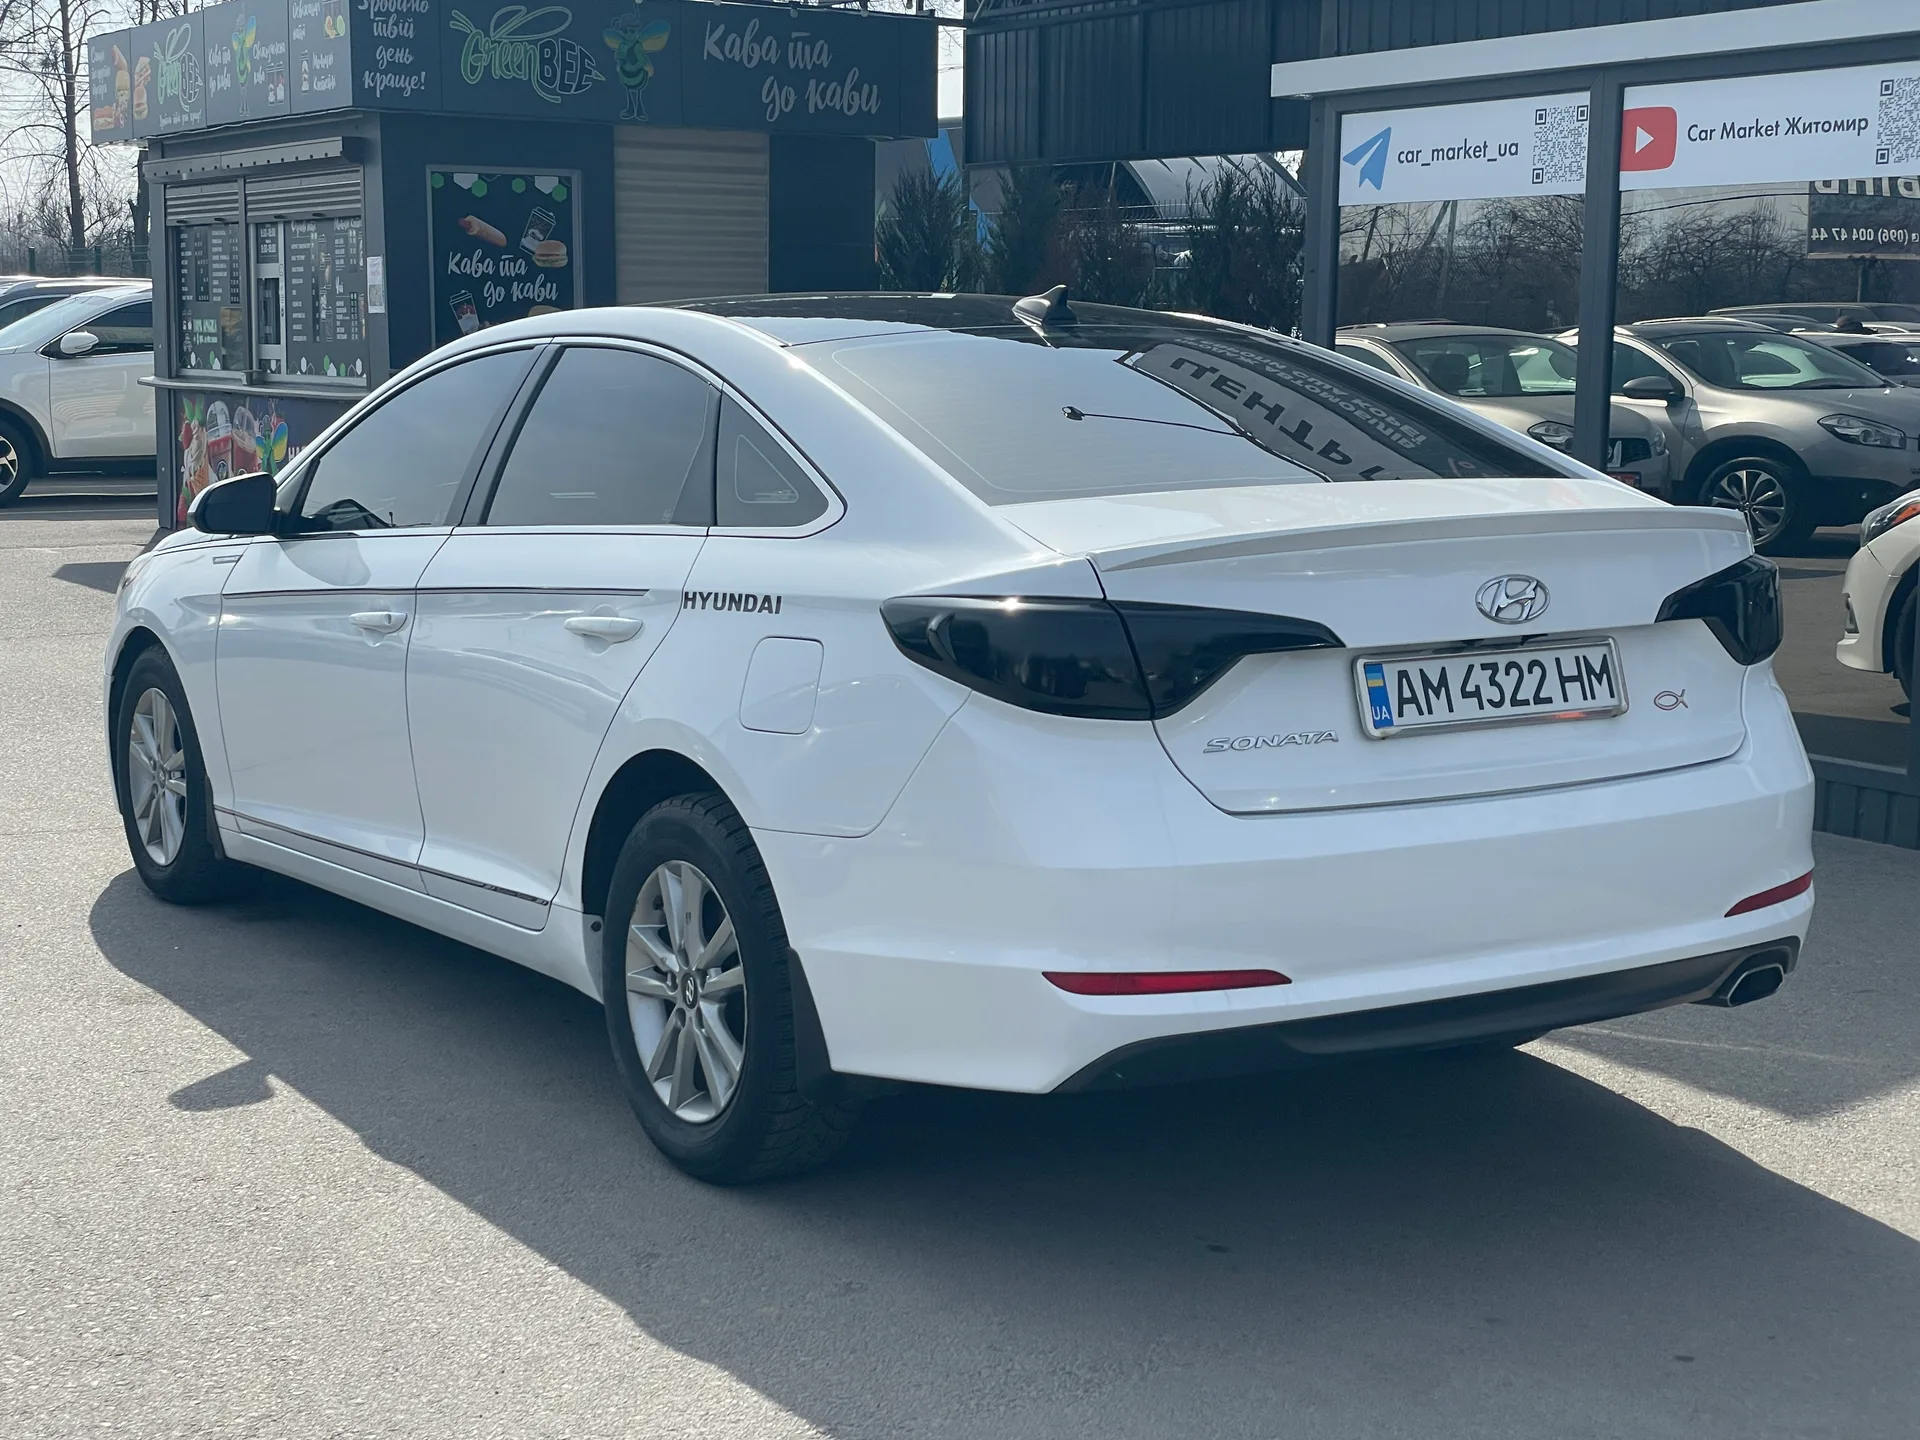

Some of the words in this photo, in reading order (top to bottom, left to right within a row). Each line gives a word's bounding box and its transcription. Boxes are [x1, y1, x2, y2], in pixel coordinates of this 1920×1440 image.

[373, 16, 415, 39] твій
[376, 45, 414, 69] день
[703, 18, 781, 69] Кава
[788, 31, 832, 70] та
[362, 71, 426, 97] краще!
[761, 75, 797, 122] до
[805, 67, 881, 116] кави
[1687, 124, 1716, 142] Car
[1720, 118, 1779, 140] Market
[1784, 117, 1869, 137] Житомир
[1397, 138, 1519, 167] car_market_ua
[448, 248, 496, 278] Кава
[500, 254, 529, 277] та
[483, 281, 506, 308] до
[511, 273, 559, 303] кави
[682, 591, 782, 614] HYUNDAI
[1397, 666, 1454, 718] AM
[1460, 659, 1553, 711] 4322
[1555, 653, 1615, 702] HM
[1371, 706, 1390, 720] UA
[1203, 730, 1339, 754] SONATA
